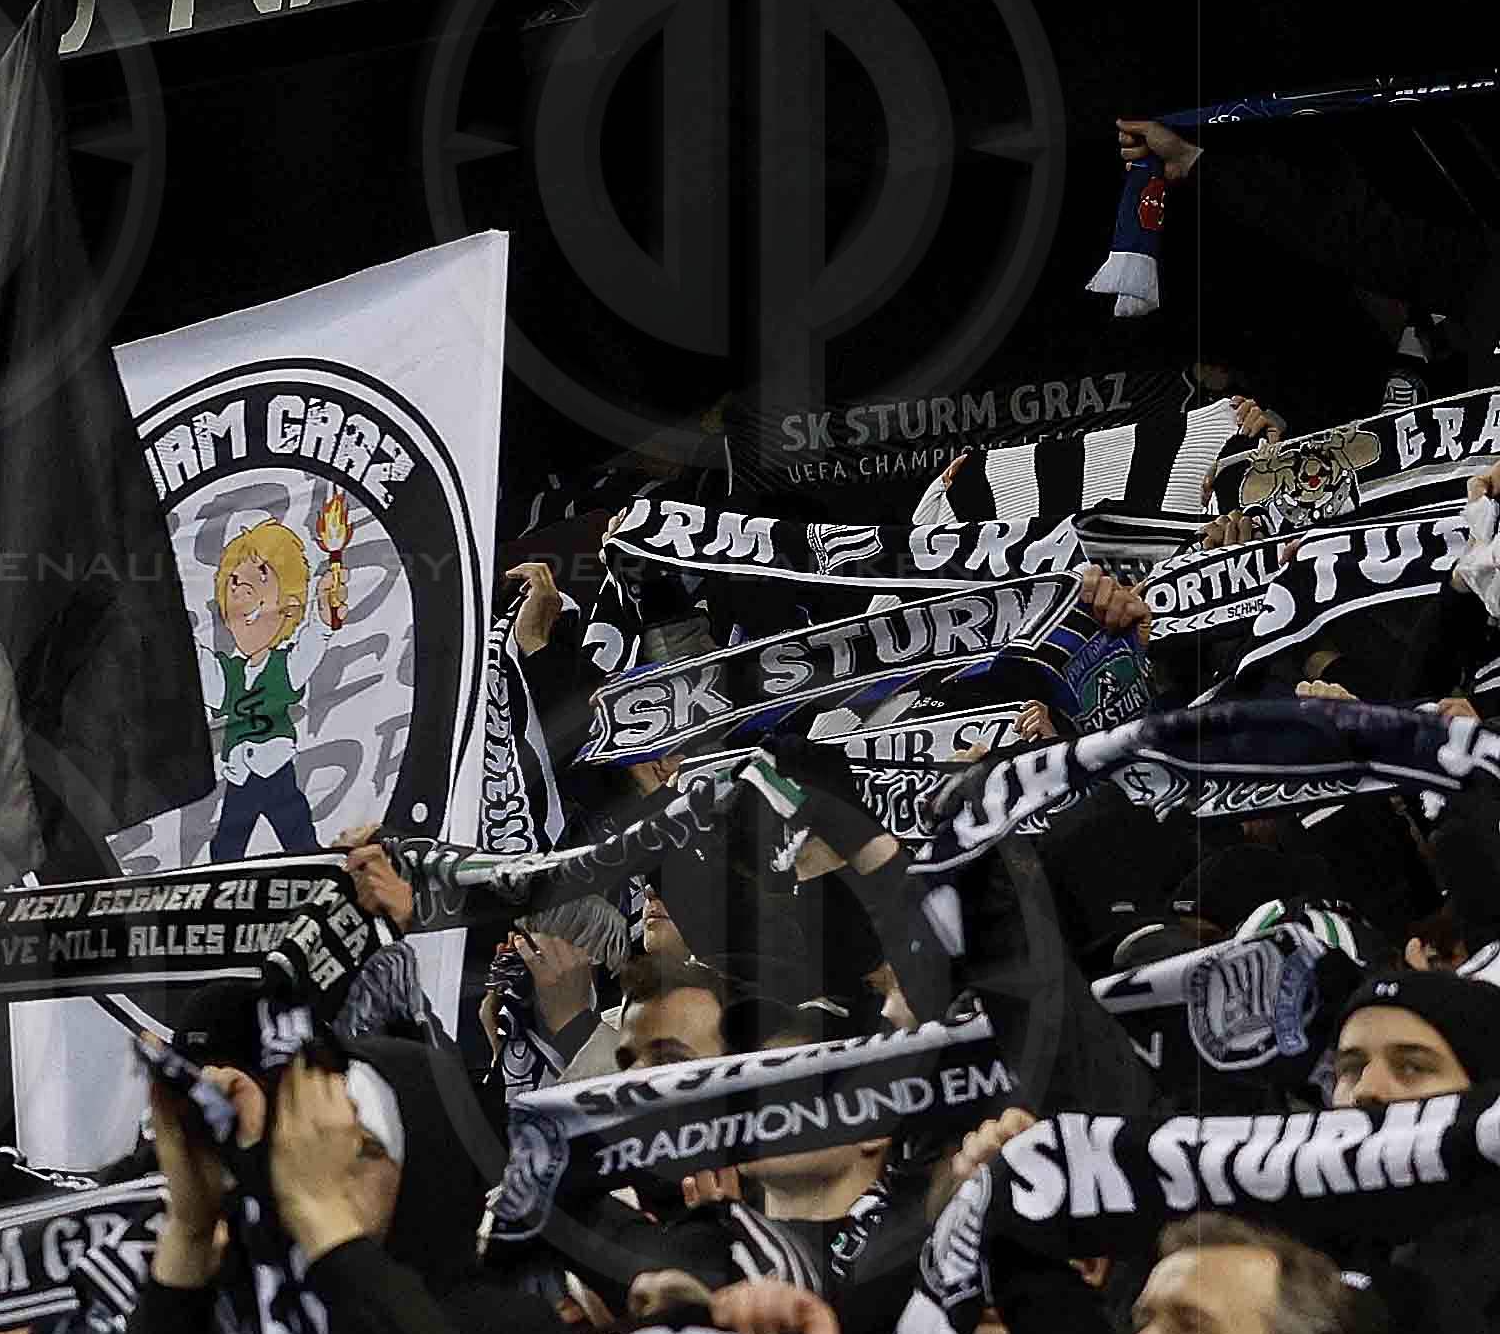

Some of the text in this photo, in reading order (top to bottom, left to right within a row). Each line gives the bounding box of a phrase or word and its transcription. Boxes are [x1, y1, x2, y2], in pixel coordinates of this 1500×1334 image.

[266, 397, 418, 510] GRAZ
[780, 372, 1134, 452] SK STURM GRAZ
[606, 665, 732, 747] SK
[760, 581, 1063, 697] STURM
[127, 923, 226, 959] ALLES
[213, 879, 257, 911] ZU
[598, 1095, 830, 1177] TRADITION
[832, 1076, 937, 1127] UND
[1000, 1095, 1464, 1225] SK STURM
